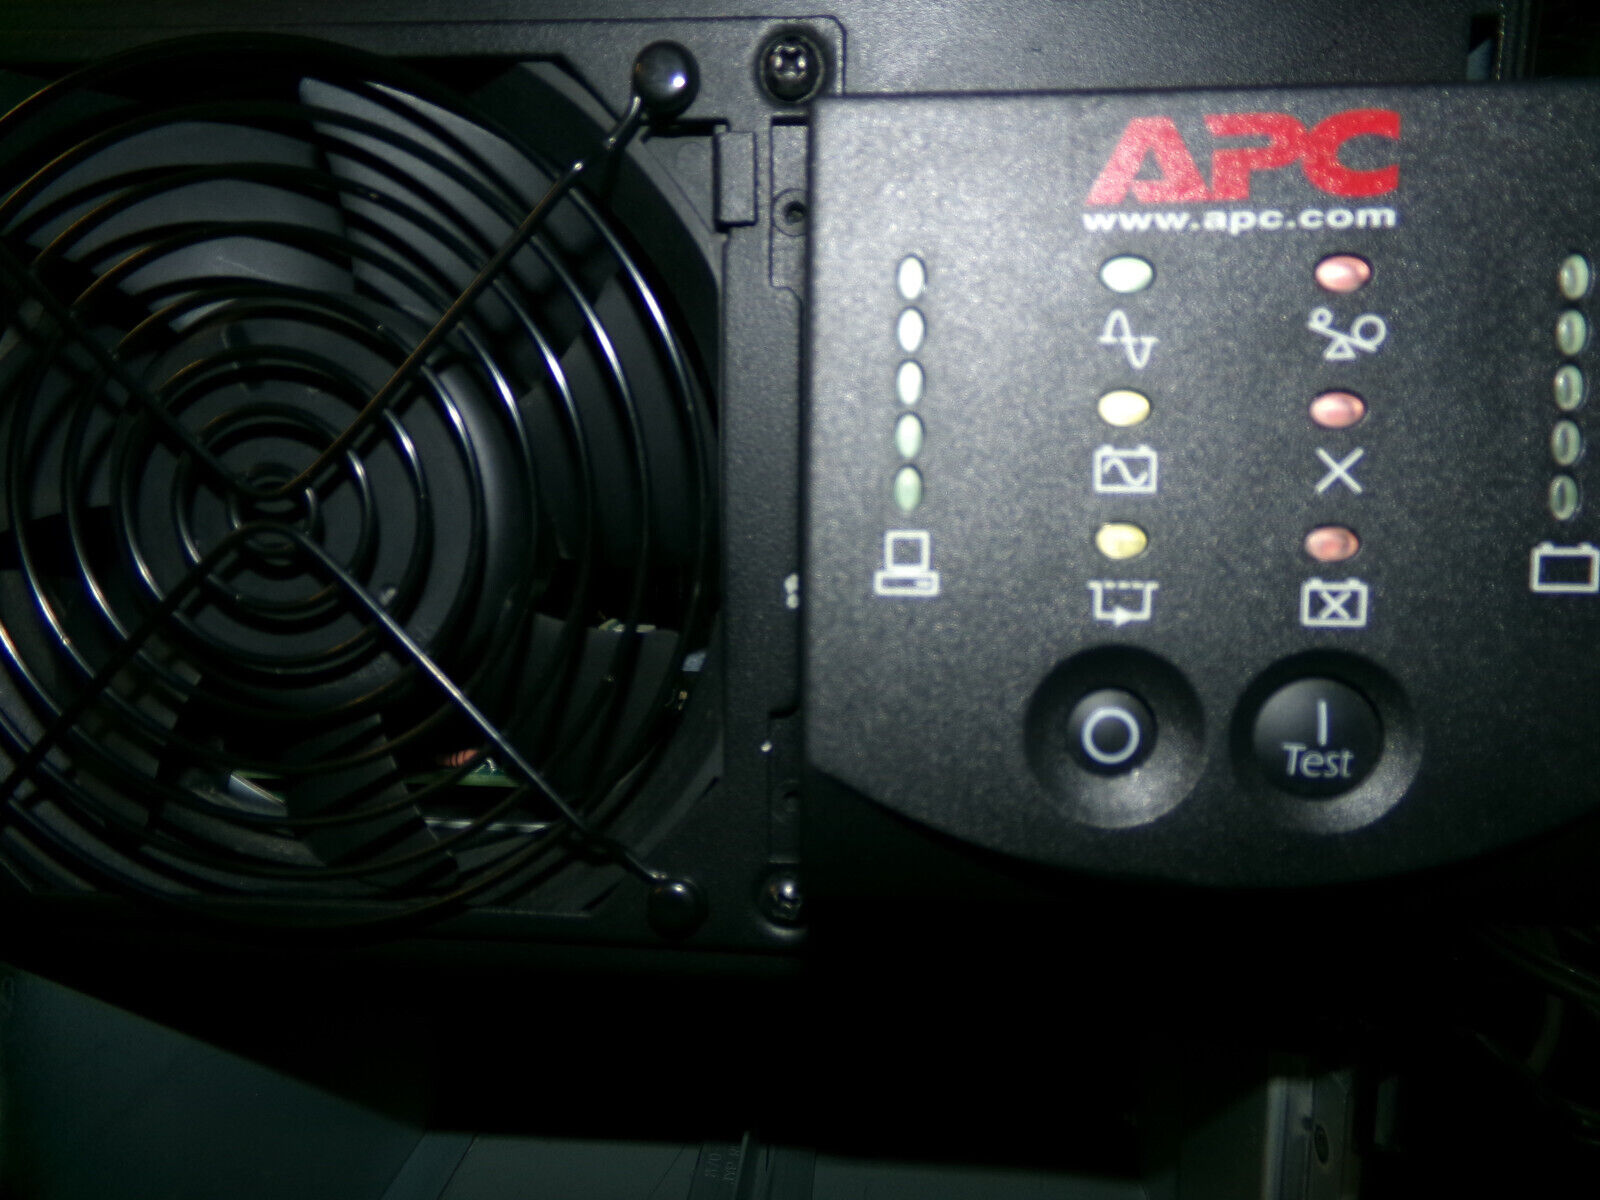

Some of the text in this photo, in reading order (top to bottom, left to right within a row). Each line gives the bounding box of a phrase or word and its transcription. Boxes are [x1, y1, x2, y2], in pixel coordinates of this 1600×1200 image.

[1086, 108, 1401, 205] APC
[1082, 206, 1397, 235] www.apc.com
[1283, 742, 1354, 778] Test
